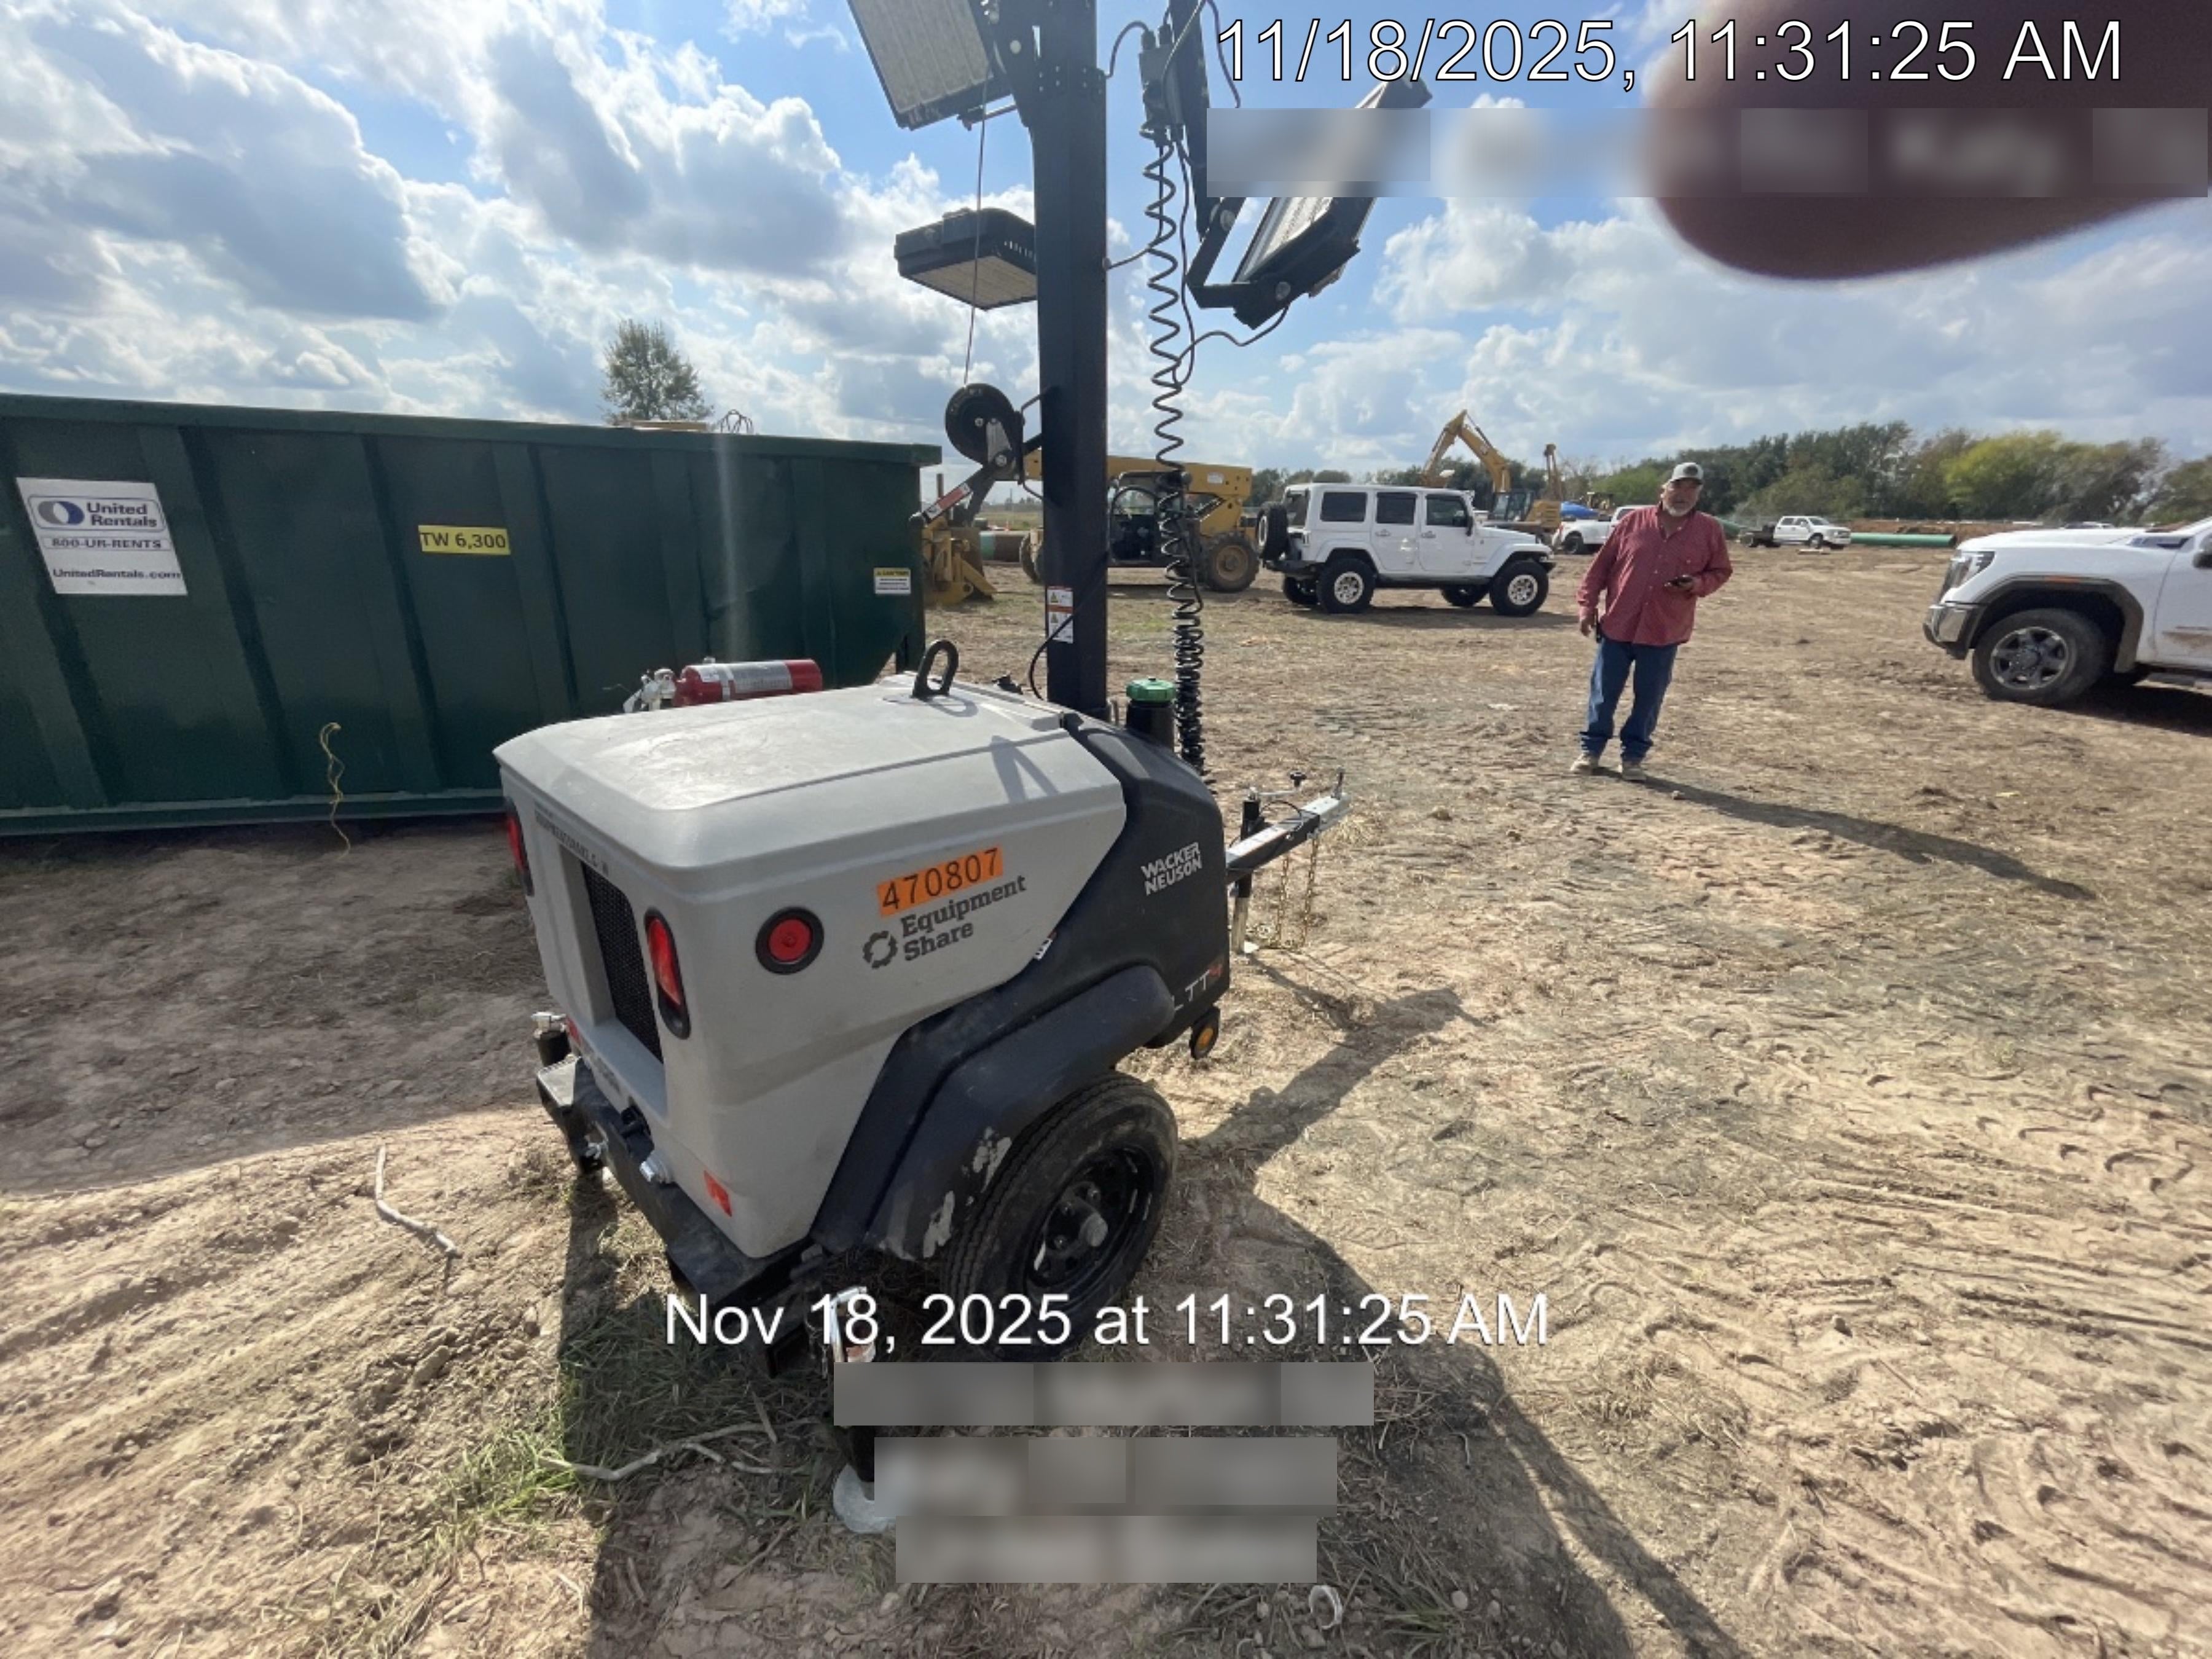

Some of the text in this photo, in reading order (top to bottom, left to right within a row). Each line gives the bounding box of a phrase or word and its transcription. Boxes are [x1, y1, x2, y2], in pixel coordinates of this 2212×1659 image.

[87, 501, 147, 515] United
[91, 514, 157, 528] Rentals
[52, 537, 162, 549] 800-UR-RENTS
[420, 532, 506, 549] TW 6,300
[53, 568, 182, 579] UnitedRentals.com
[1140, 842, 1201, 879] WACKER
[882, 847, 998, 910] 470807
[1144, 855, 1202, 896] NEUSON
[900, 875, 1027, 938] Equipment
[903, 922, 975, 961] Share
